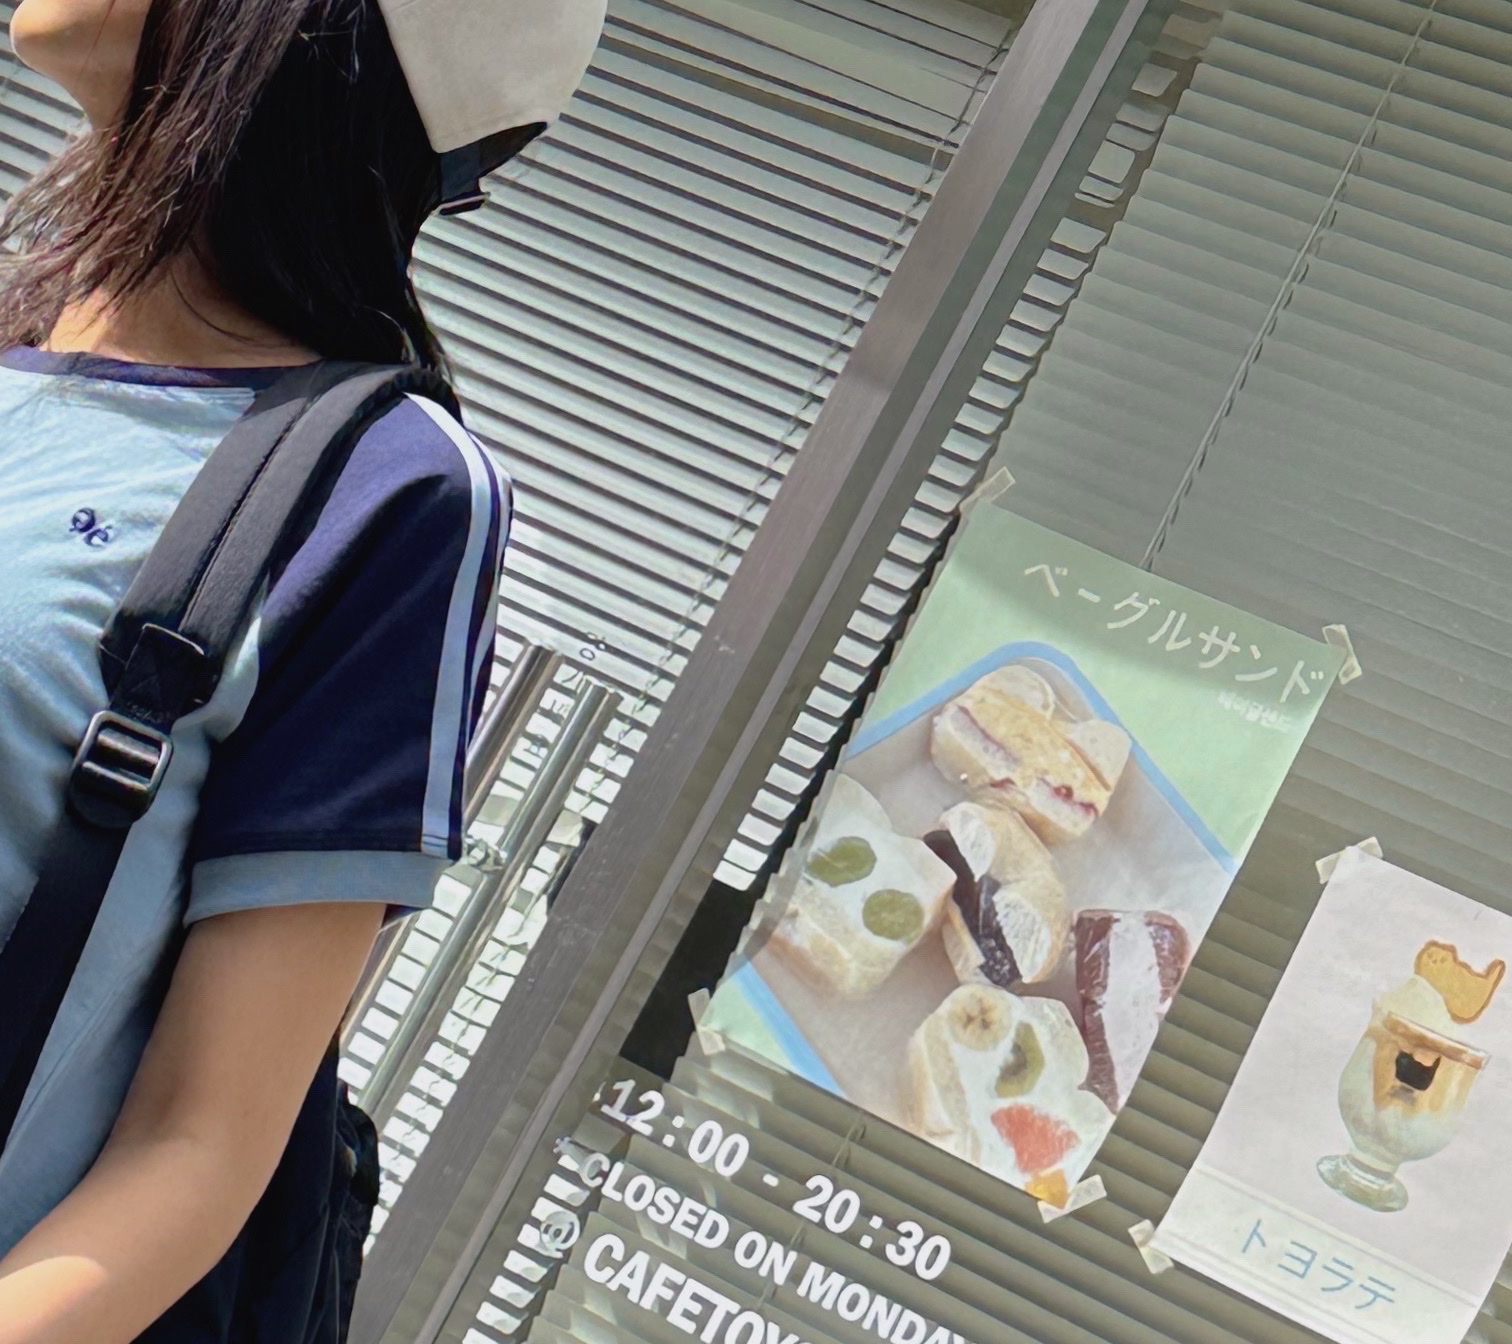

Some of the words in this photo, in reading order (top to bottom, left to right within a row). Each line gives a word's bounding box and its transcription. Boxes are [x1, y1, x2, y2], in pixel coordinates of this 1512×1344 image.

[1023, 563, 1325, 704] ベーグルサンド
[577, 1152, 730, 1249] CLOSED
[733, 1230, 798, 1286] ON
[600, 1078, 750, 1177] 12:00
[792, 1174, 952, 1281] 20:30
[1240, 1218, 1397, 1310] トヨラテ
